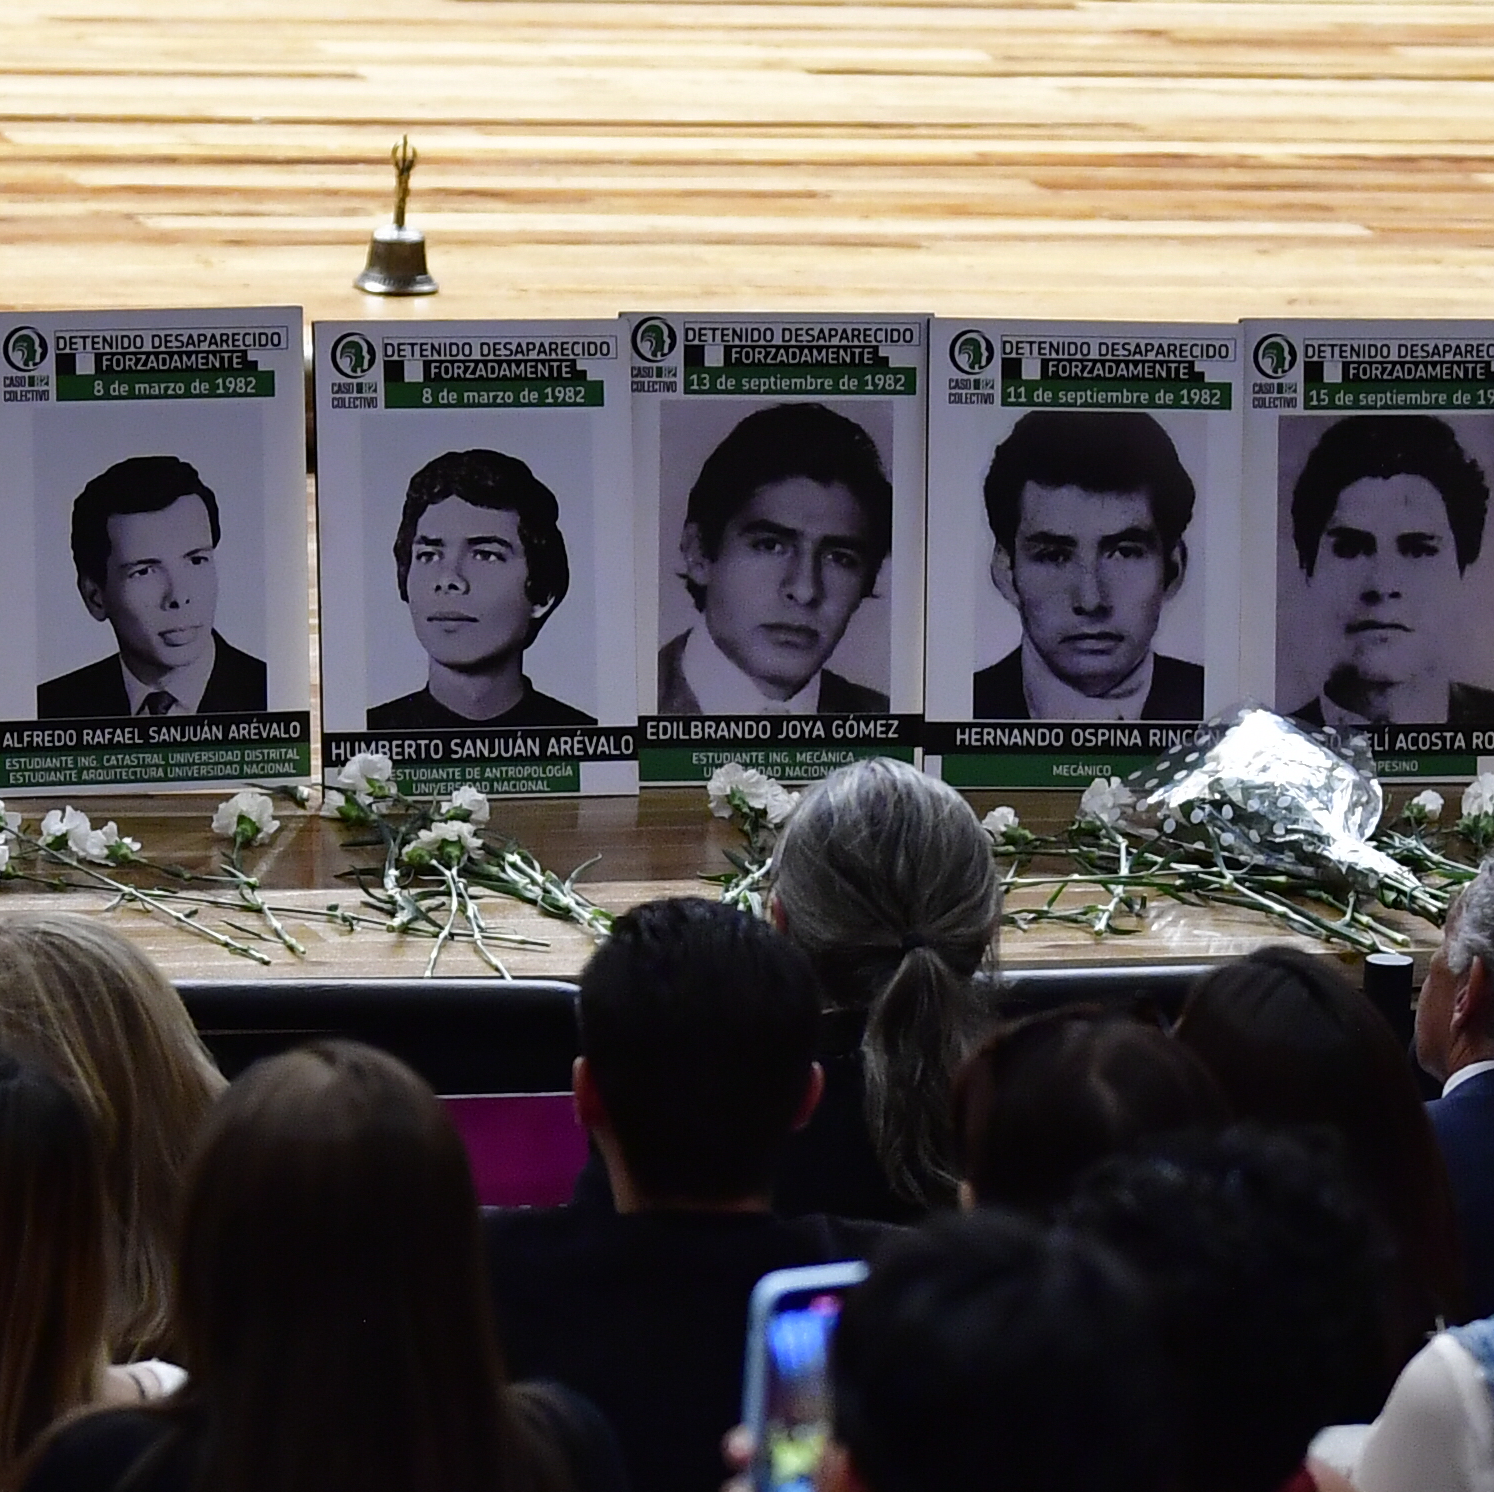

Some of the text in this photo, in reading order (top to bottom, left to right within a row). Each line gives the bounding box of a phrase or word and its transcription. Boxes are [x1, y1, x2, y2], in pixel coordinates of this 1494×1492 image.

[57, 332, 281, 351] DETENIDO DESAPARECIDO
[685, 327, 913, 343] DETENIDO DESAPARECIDO
[385, 341, 610, 358] DETENIDO DESAPARECIDO
[732, 348, 873, 364] FORZADAMENTE
[1003, 340, 1229, 358] DETENIDO DESAPARECIDO
[1305, 344, 1390, 359] DETENIDO
[103, 353, 242, 370] FORZADAMENTE
[431, 362, 571, 378] FORZADAMENTE
[1049, 362, 1189, 378] FORZADAMENTE
[1349, 364, 1485, 379] FORZADAMENTE
[422, 388, 585, 403] 8 de marzo de 1982
[1007, 388, 1221, 405] 11 de septiembre de 1982
[3, 719, 300, 748] ALFREDO RAFAEL SANJUÁN ARÉVALO
[647, 714, 899, 739] EDILBRANDO JOYA GÓMEZ
[957, 728, 1063, 745] HERNANDO
[1071, 728, 1141, 746] OSPINA
[1395, 732, 1465, 750] ACOSTA
[332, 731, 633, 761] HUMBERTO SANJUÁN ARÉVALO
[6, 748, 299, 770] ESTUDIANTE ING. CATASTRAL UNIVERSIDAD DISTRITAL
[693, 750, 854, 764] ESTUDIANTE ING. MECÁNICA
[10, 763, 296, 783] ESTUDIANTE ARQUITECTURA UNIVERSIDAD NACIONAL
[466, 768, 480, 778] DE
[485, 762, 573, 778] ANTROPOLOGÍA
[1053, 762, 1111, 776] MECÁNICO
[493, 781, 550, 792] NACIONAL
